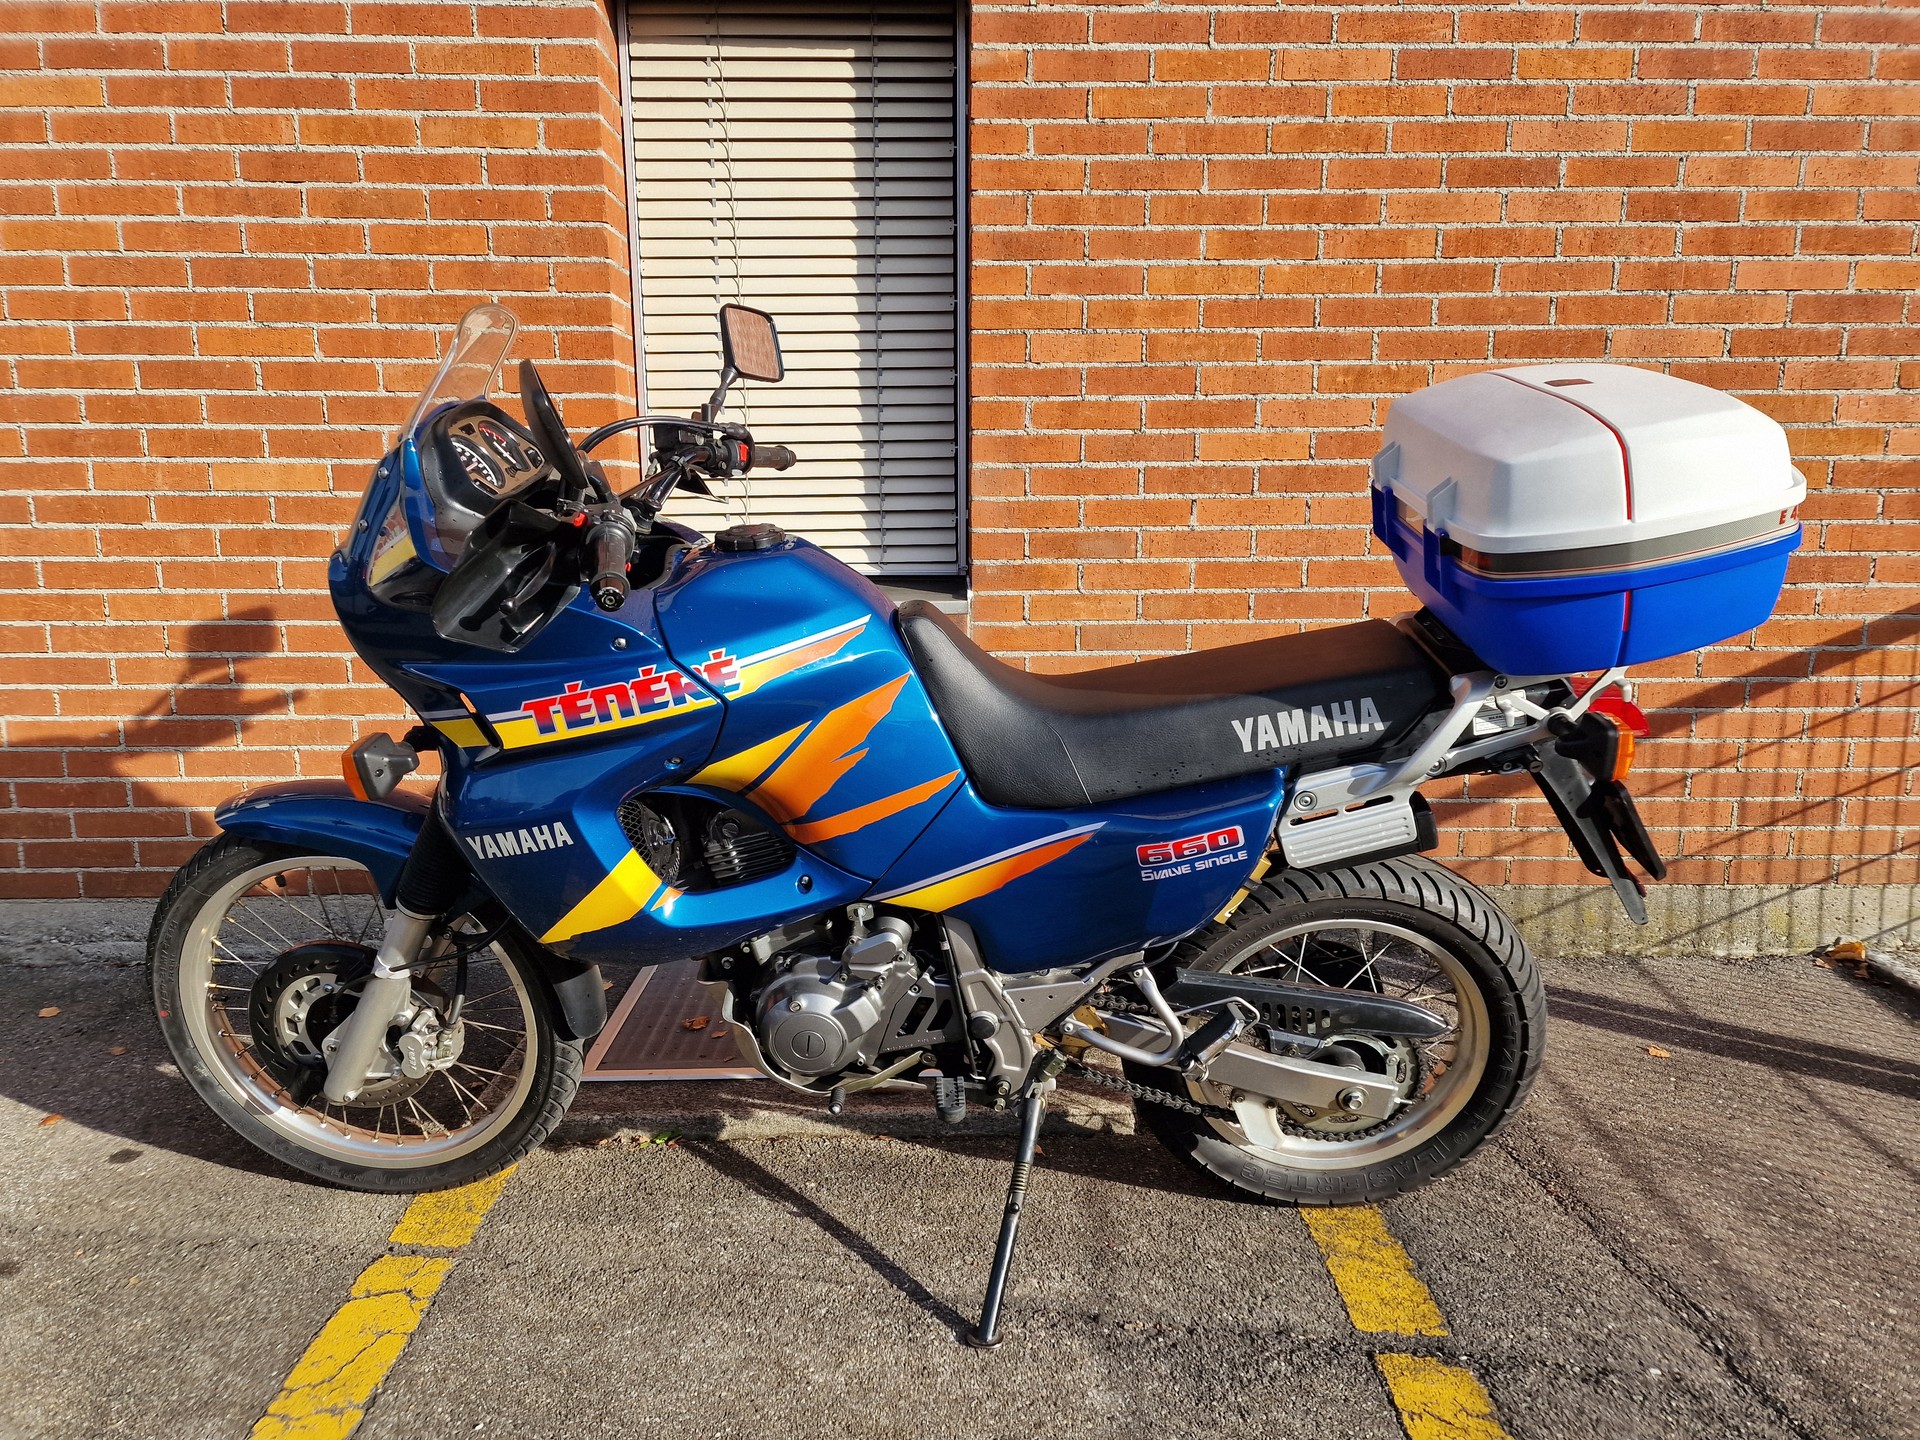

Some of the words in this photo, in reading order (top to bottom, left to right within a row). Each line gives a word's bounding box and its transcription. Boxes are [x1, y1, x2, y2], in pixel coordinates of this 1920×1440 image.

[1778, 508, 1788, 525] E
[522, 648, 744, 736] TÉNÉRÉ
[1230, 697, 1385, 753] YAMAHA
[465, 821, 574, 860] YAMAHA
[1136, 825, 1245, 867] 660
[1141, 864, 1192, 882] 5VALVE
[1194, 850, 1248, 871] SINGLE
[1240, 1136, 1450, 1194] LASERTEC
